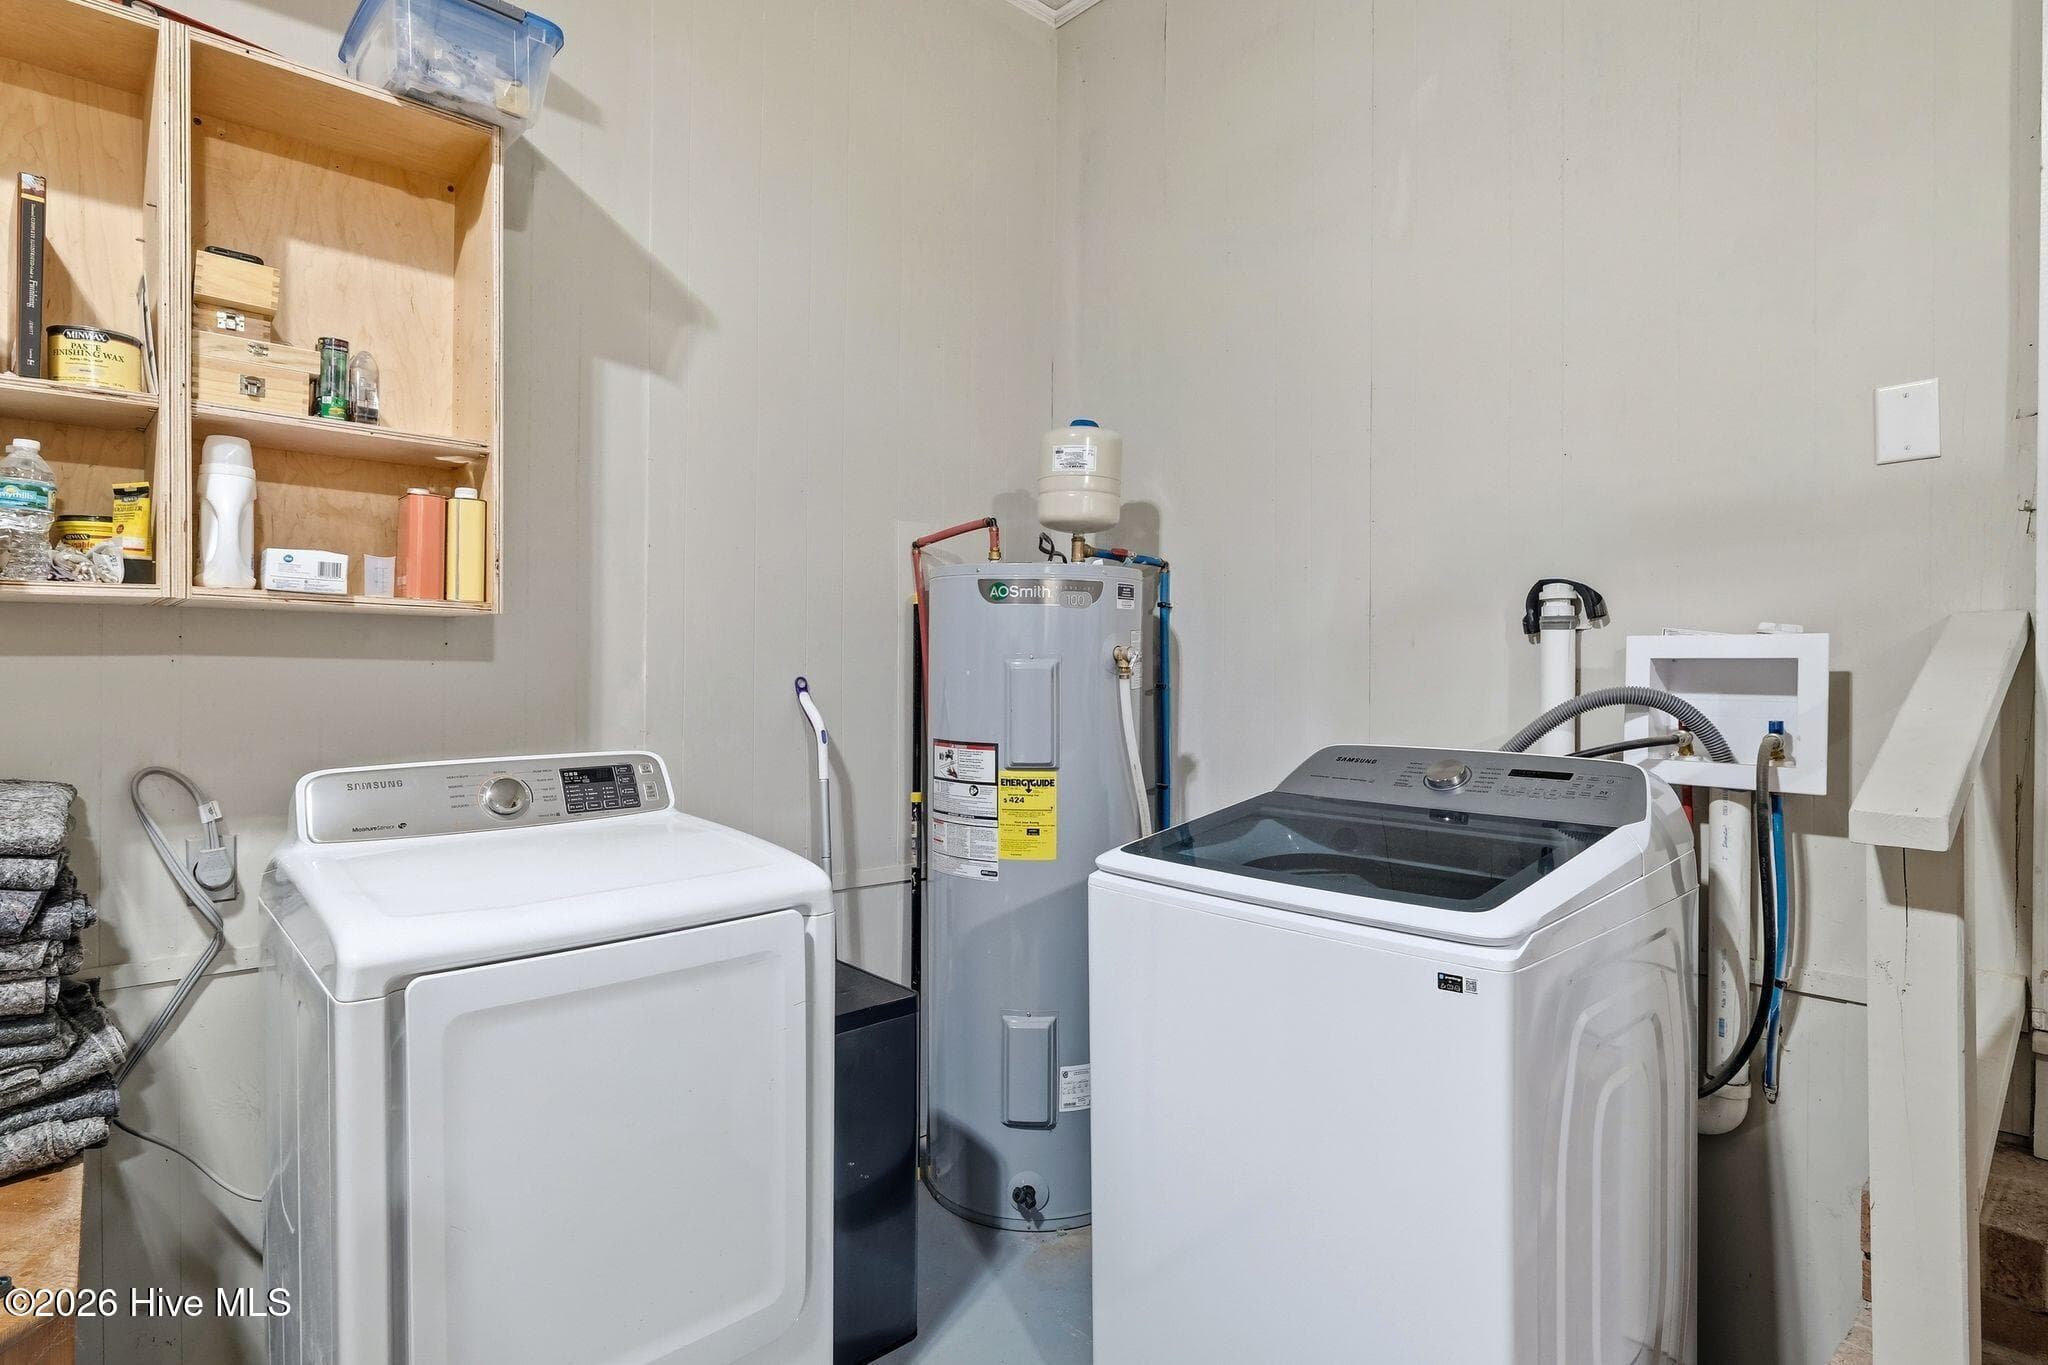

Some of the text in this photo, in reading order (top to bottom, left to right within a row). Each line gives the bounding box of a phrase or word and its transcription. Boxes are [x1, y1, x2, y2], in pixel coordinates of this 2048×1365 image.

[66, 330, 106, 341] MINWAX
[71, 342, 102, 352] PASE
[102, 352, 125, 363] WAX
[1335, 756, 1378, 765] SAMSUNG
[346, 780, 403, 791] SAMSUNG
[1009, 796, 1024, 804] 424
